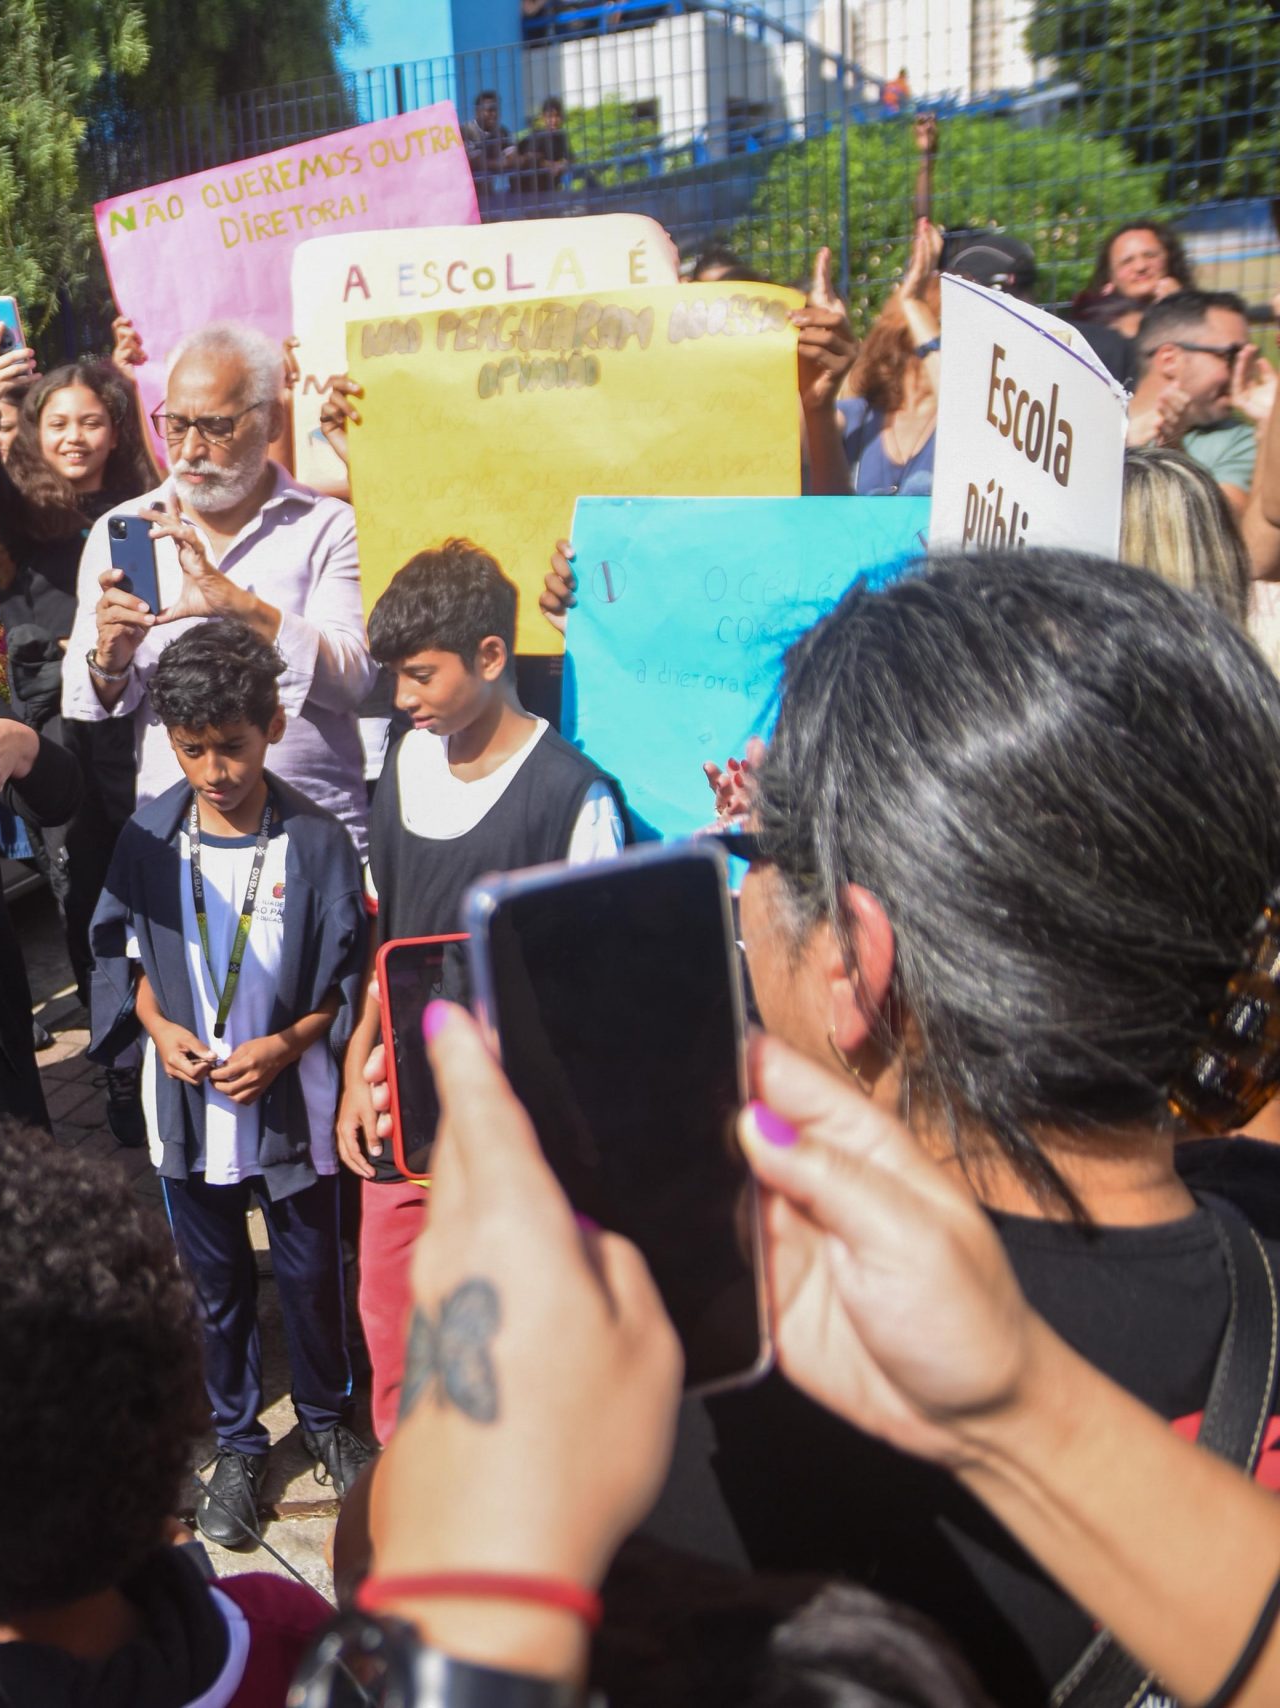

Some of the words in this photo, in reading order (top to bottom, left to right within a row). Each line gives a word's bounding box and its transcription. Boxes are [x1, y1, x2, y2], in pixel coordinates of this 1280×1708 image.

[108, 192, 185, 238] NÃO
[201, 145, 362, 210] QUEREMOS
[369, 124, 463, 169] OUTRA
[342, 263, 372, 302] A
[628, 239, 650, 286] É
[986, 342, 1074, 488] Escola
[246, 867, 261, 901] OXBAR
